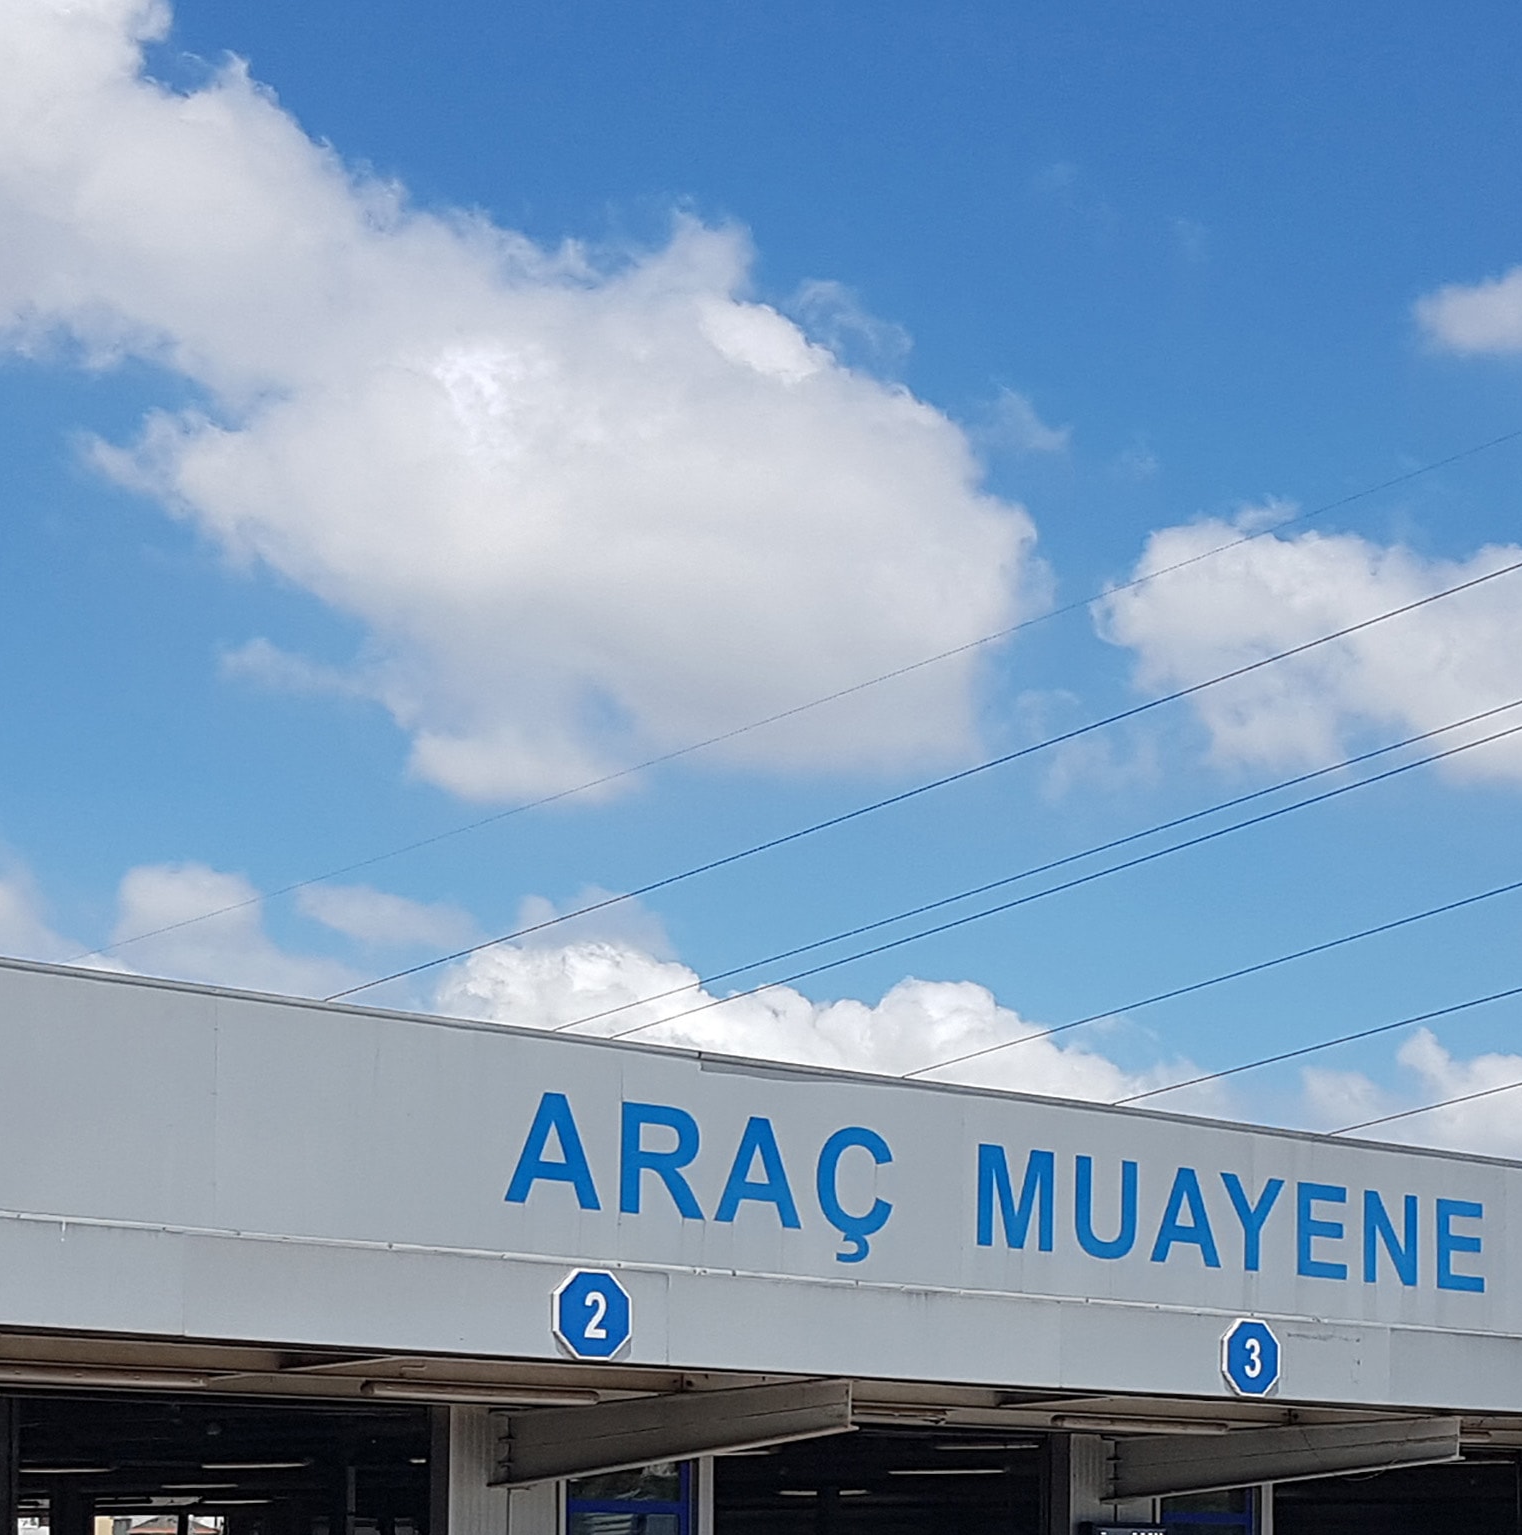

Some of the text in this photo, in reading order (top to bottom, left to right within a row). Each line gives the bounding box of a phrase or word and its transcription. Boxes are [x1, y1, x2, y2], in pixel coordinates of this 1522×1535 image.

[505, 1092, 894, 1264] ARAÇ
[977, 1143, 1486, 1295] MUAYENE
[583, 1290, 608, 1340] 2
[1243, 1337, 1263, 1379] 3
